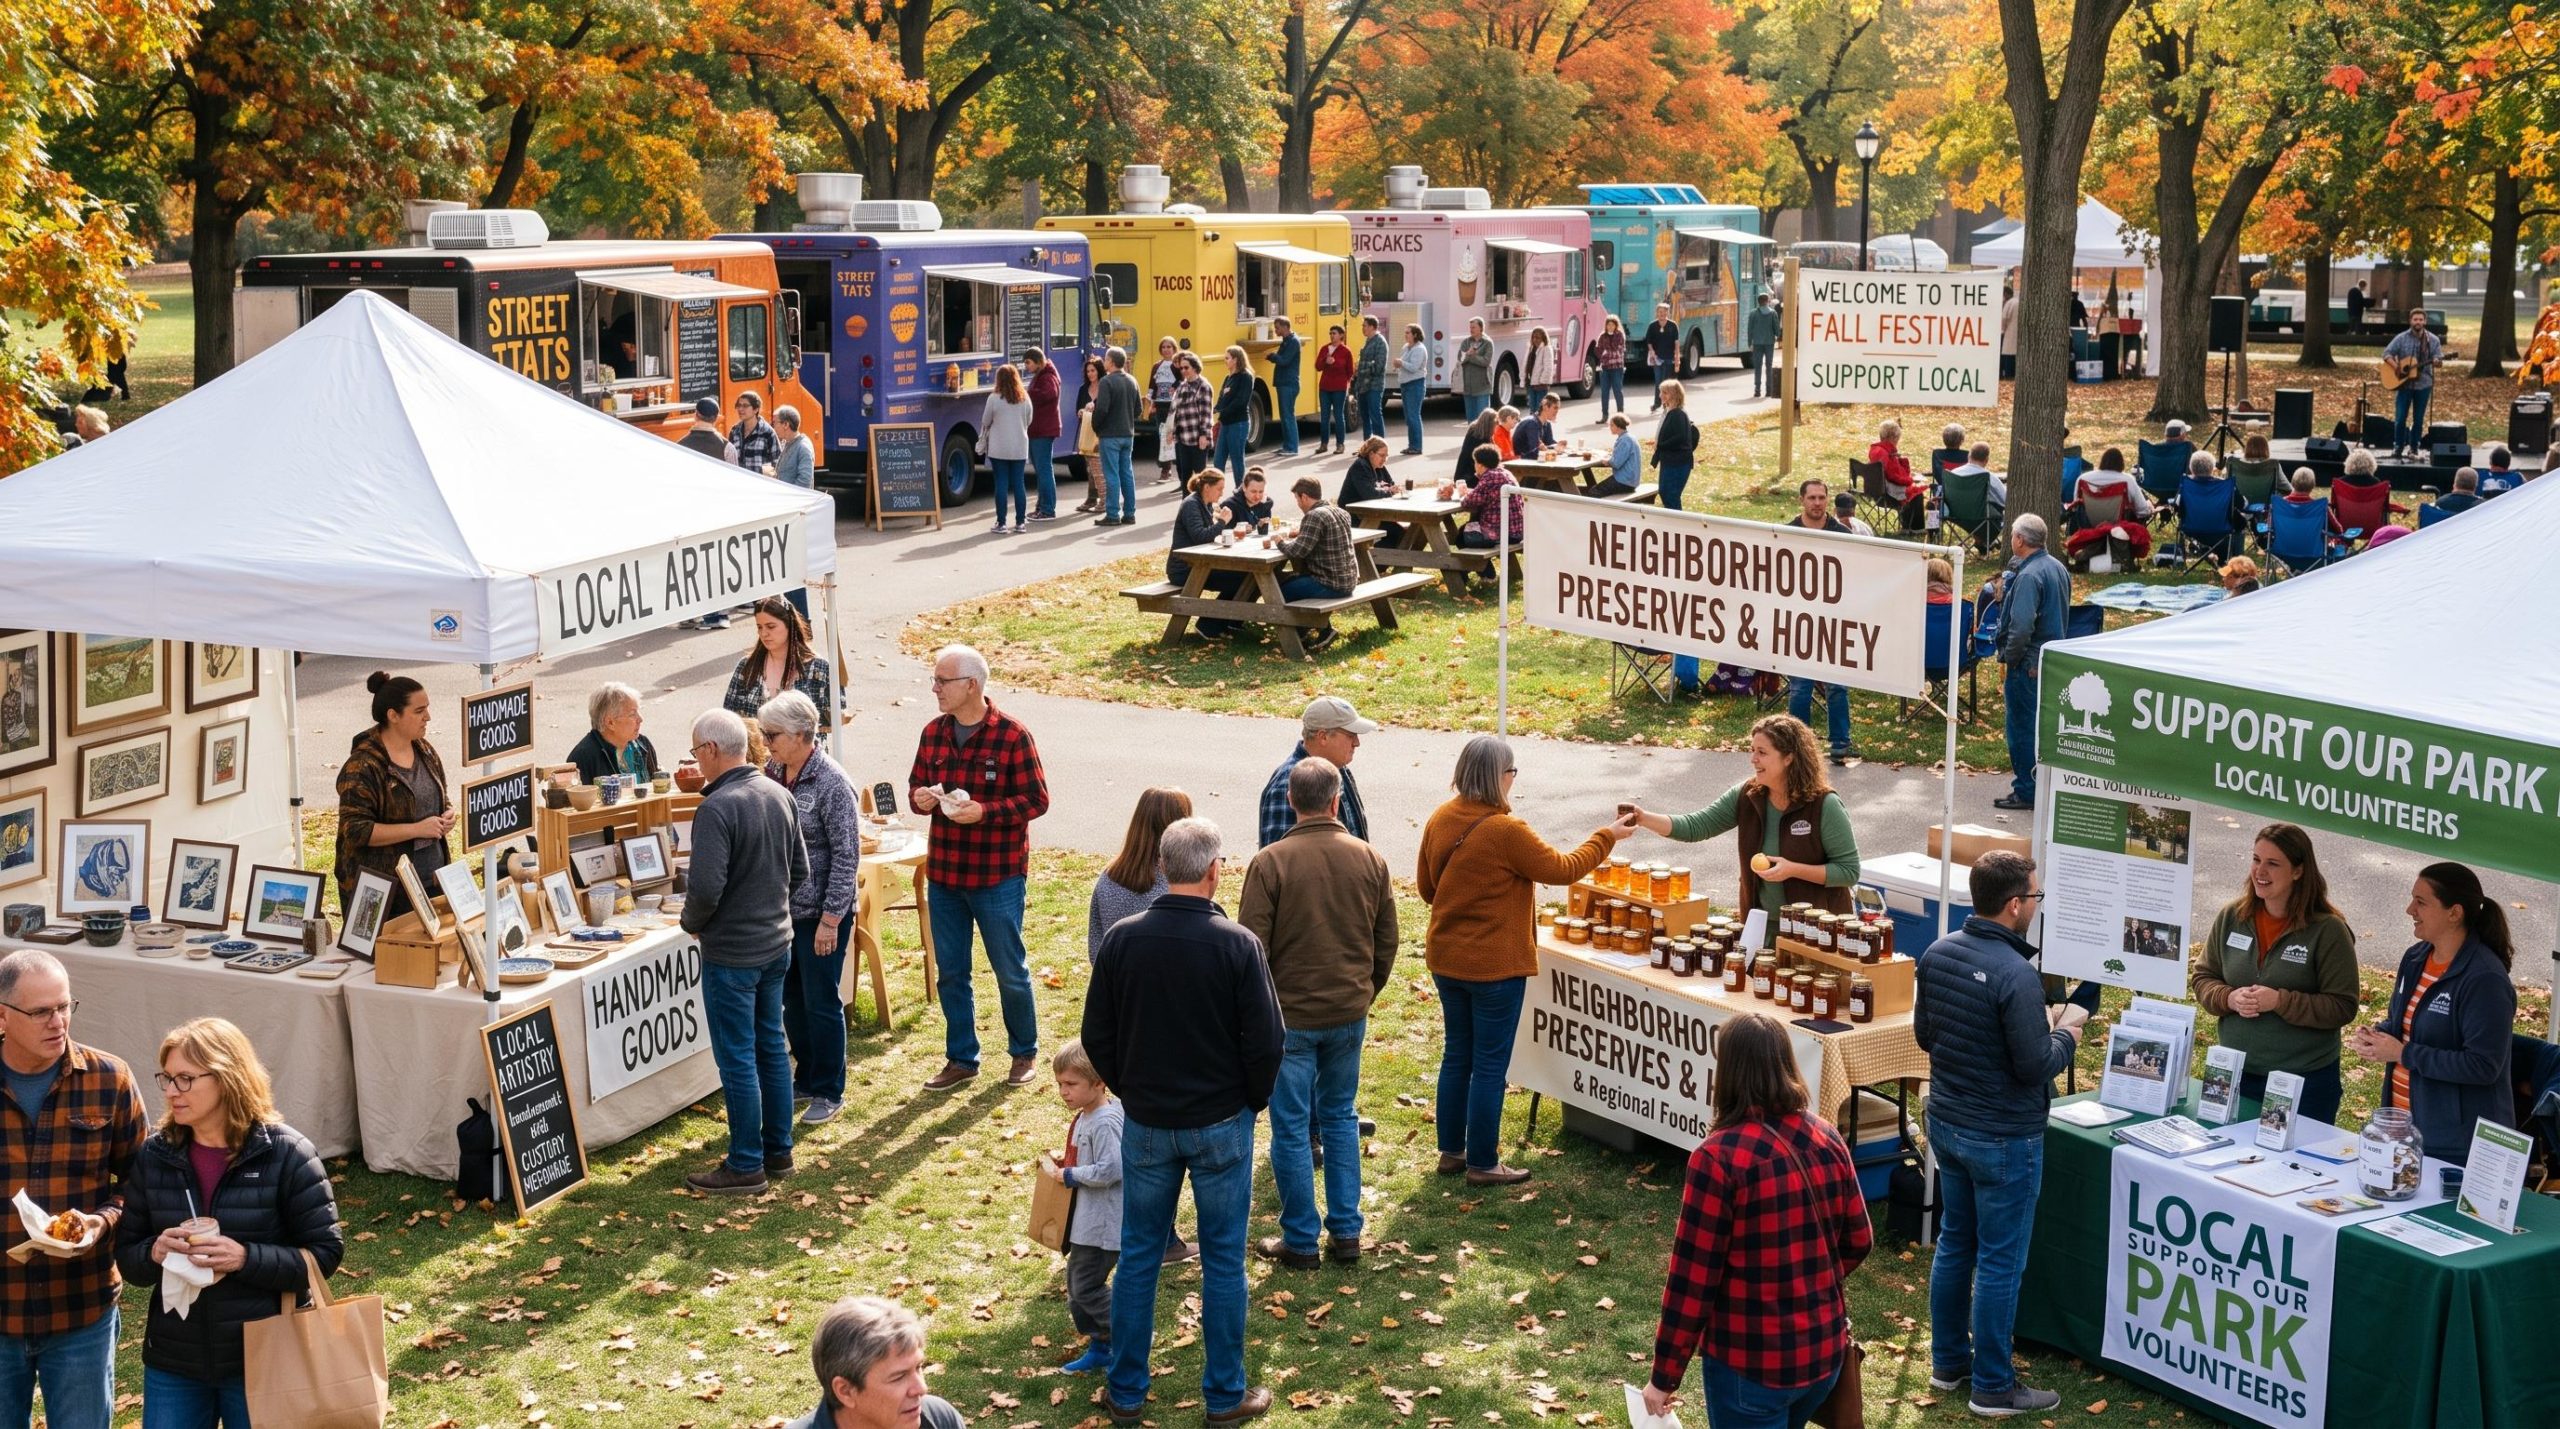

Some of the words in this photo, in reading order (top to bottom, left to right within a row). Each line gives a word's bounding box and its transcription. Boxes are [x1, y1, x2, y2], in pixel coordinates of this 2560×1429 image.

[837, 271, 876, 282] STREET
[841, 284, 872, 297] TATS
[1153, 275, 1193, 291] TACOS
[1200, 274, 1235, 301] TACOS
[1811, 281, 1907, 305] WELCOME
[1917, 283, 1942, 306] TO
[1951, 284, 1989, 306] THE
[488, 294, 570, 338] STREET
[1810, 312, 1868, 343] FALL
[1879, 314, 1990, 347] FESTIVAL
[1811, 363, 1909, 391] SUPPORT
[1919, 366, 1986, 393] LOCAL
[556, 559, 653, 640] LOCAL
[665, 524, 790, 611] ARTISTRY
[1588, 520, 1843, 605] NEIGHBORHOOD
[1558, 572, 1726, 644] PRESERVES
[1738, 603, 1759, 651] &
[1773, 608, 1882, 672] HONEY
[468, 693, 528, 728] HANDMADE
[479, 721, 517, 751] GOODS
[2131, 687, 2313, 762] SUPPORT
[2321, 725, 2413, 786] OUR
[2425, 744, 2548, 814] PARK
[468, 775, 529, 814] HANDMADE
[2063, 774, 2100, 790] VOCAL
[2214, 762, 2289, 803] LOCAL
[2295, 779, 2459, 841] VOLUNTEERS
[480, 804, 518, 836] GOODS
[592, 945, 701, 1030] HANDMAD
[496, 1020, 545, 1060] LOCAL
[622, 999, 698, 1072] GOODS
[1533, 1007, 1671, 1090] PRESERVES
[1679, 1059, 1697, 1101] &
[498, 1044, 555, 1094] ARTISTRY
[1573, 1070, 1584, 1094] &
[1589, 1075, 1655, 1120] Regional
[2128, 1181, 2309, 1291] LOCAL
[2128, 1232, 2241, 1285] SUPPORT
[2253, 1278, 2308, 1313] OUR
[2126, 1253, 2308, 1383] PARK
[2124, 1320, 2308, 1419] VOLUNTEERS
